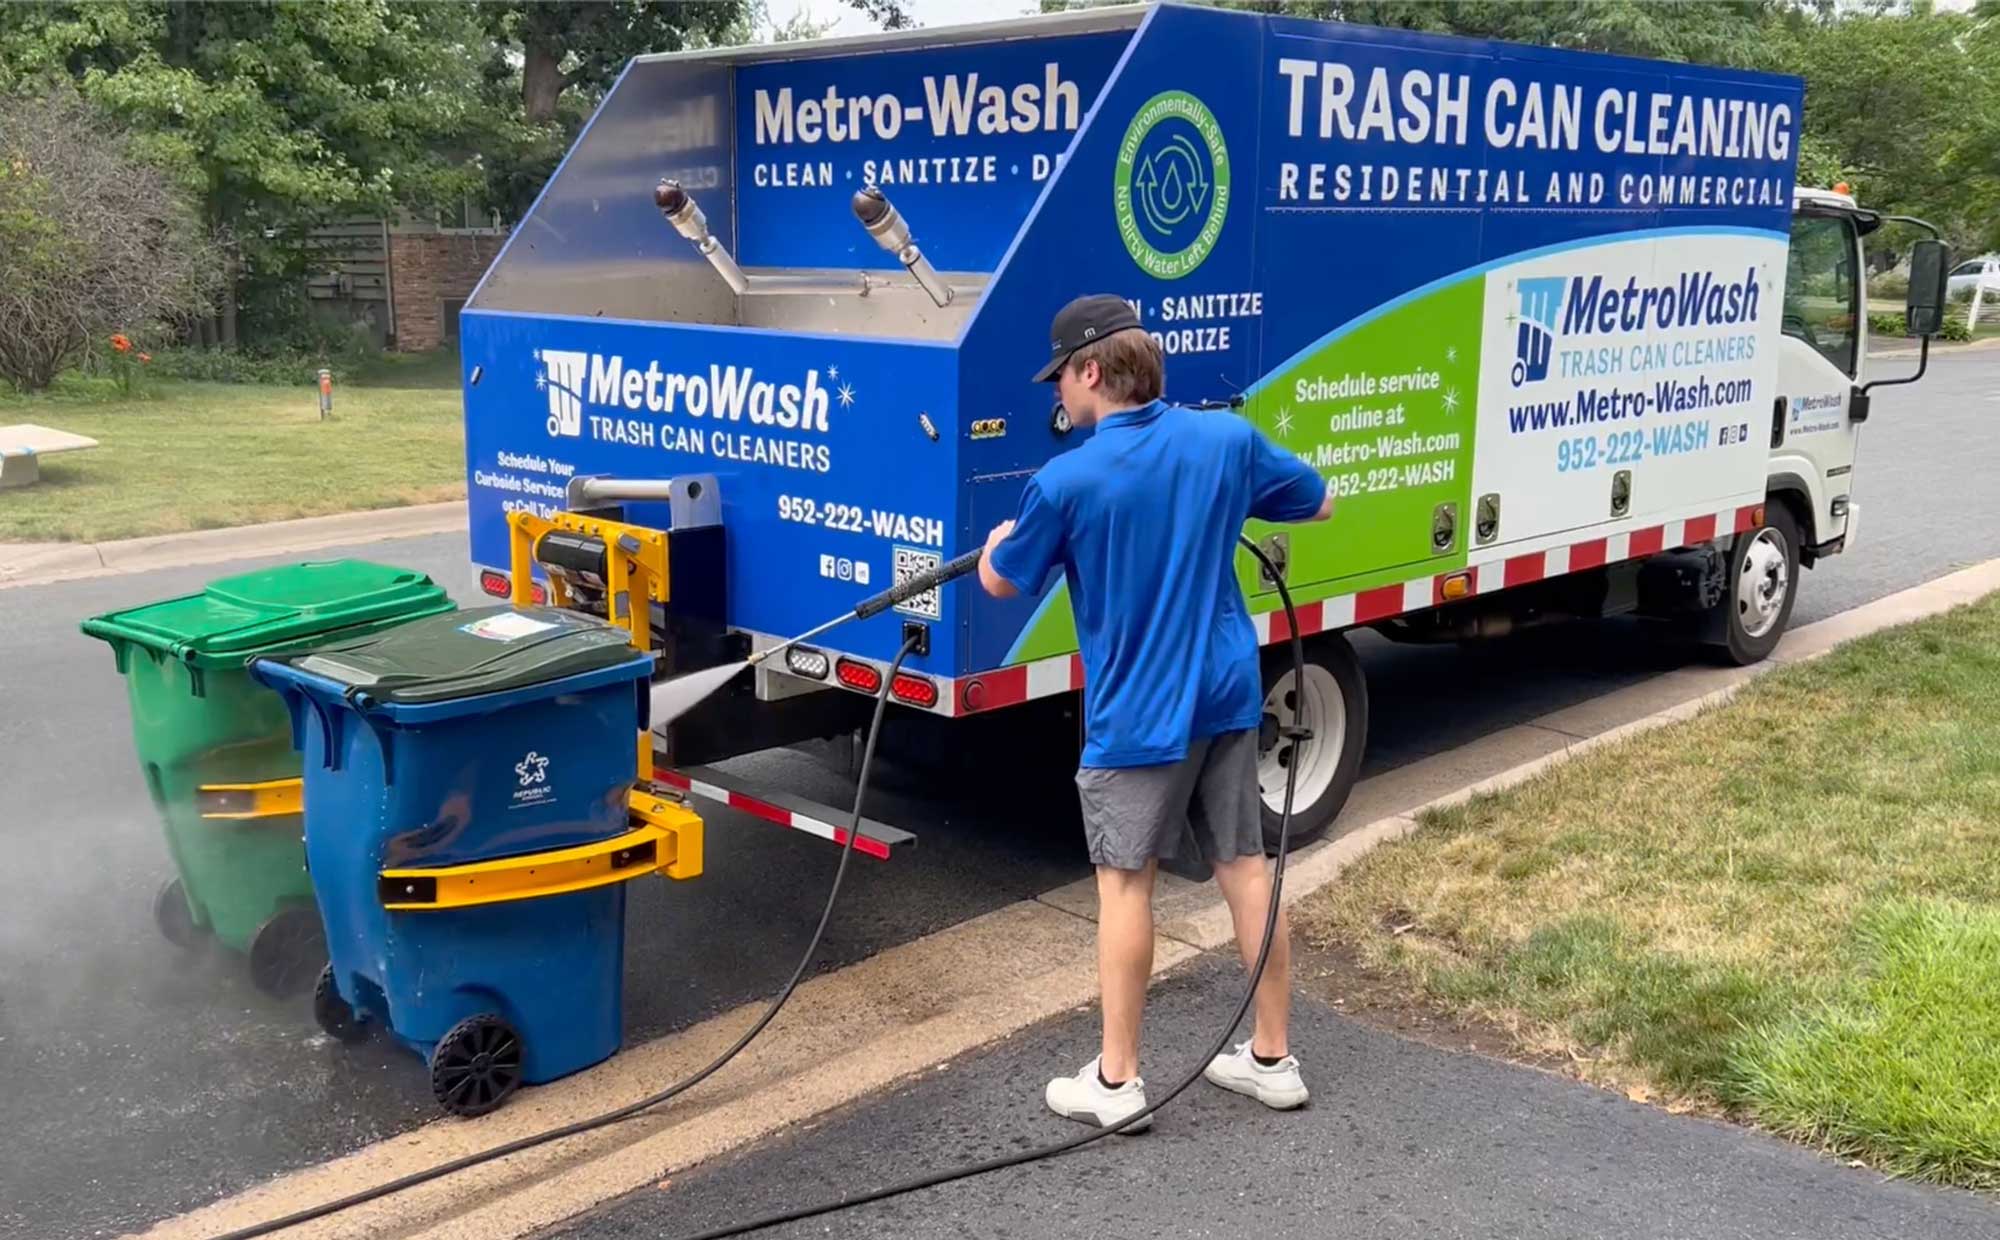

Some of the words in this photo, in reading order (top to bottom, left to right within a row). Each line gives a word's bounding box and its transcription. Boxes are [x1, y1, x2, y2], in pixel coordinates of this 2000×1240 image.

[754, 62, 1079, 145] Metro-Wash
[1279, 58, 1470, 145] TRASH
[1484, 77, 1582, 151] CAN
[1594, 87, 1791, 160] CLEANING
[1121, 97, 1226, 167] Environmentally-Safe
[754, 162, 834, 187] CLEAN
[863, 155, 997, 183] SANITIZE
[1279, 162, 1529, 203] RESIDENTIAL
[1546, 171, 1604, 204] AND
[1620, 173, 1784, 206] COMMERCIAL
[1117, 185, 1128, 211] No
[1206, 185, 1227, 245] Behind
[1121, 216, 1144, 260] Dirty
[1181, 242, 1204, 270] Left
[1143, 248, 1178, 274] Water
[1162, 293, 1263, 321] SANITIZE
[1562, 267, 1759, 336] MetroWash
[1560, 347, 1623, 378] TRASH
[1629, 341, 1667, 373] CAN
[1672, 334, 1756, 368] CLEANERS
[588, 353, 829, 433] MetroWash
[1295, 372, 1376, 402] Schedule
[1378, 366, 1440, 393] service
[1509, 374, 1752, 434] www.Metro-Wash.com
[1330, 405, 1383, 433] online
[1385, 402, 1405, 425] at
[497, 451, 547, 473] Schedule
[547, 458, 575, 476] Your
[589, 415, 655, 448] TRASH
[660, 424, 705, 455] CAN
[711, 431, 831, 473] CLEANERS
[1557, 420, 1710, 473] 952-222-WASH
[475, 470, 522, 492] Curbside
[523, 478, 564, 498] Service
[1326, 460, 1455, 498] 952-222-WASH
[778, 494, 943, 547] 952-222-WASH
